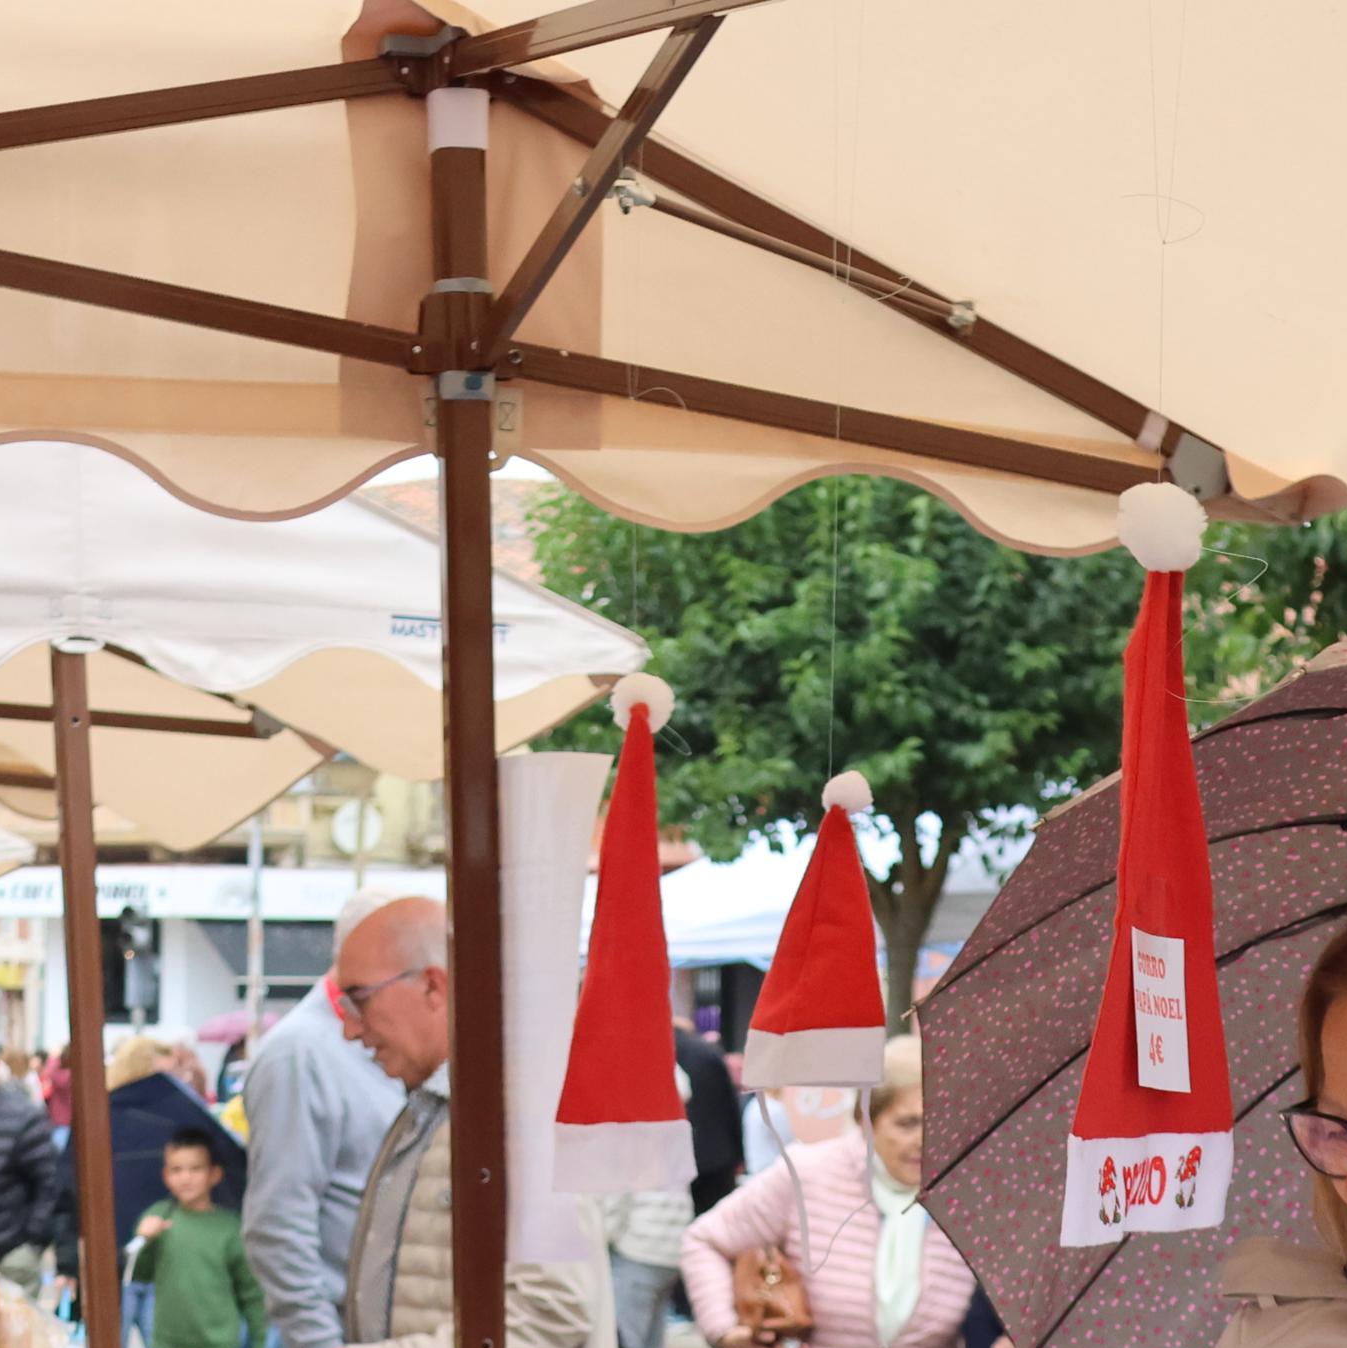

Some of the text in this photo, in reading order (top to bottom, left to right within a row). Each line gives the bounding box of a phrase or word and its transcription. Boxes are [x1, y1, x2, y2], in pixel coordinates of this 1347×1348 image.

[1137, 951, 1166, 980] GORRO
[1135, 988, 1183, 1020] PAPÁ NOEL
[1149, 1032, 1165, 1067] 4€
